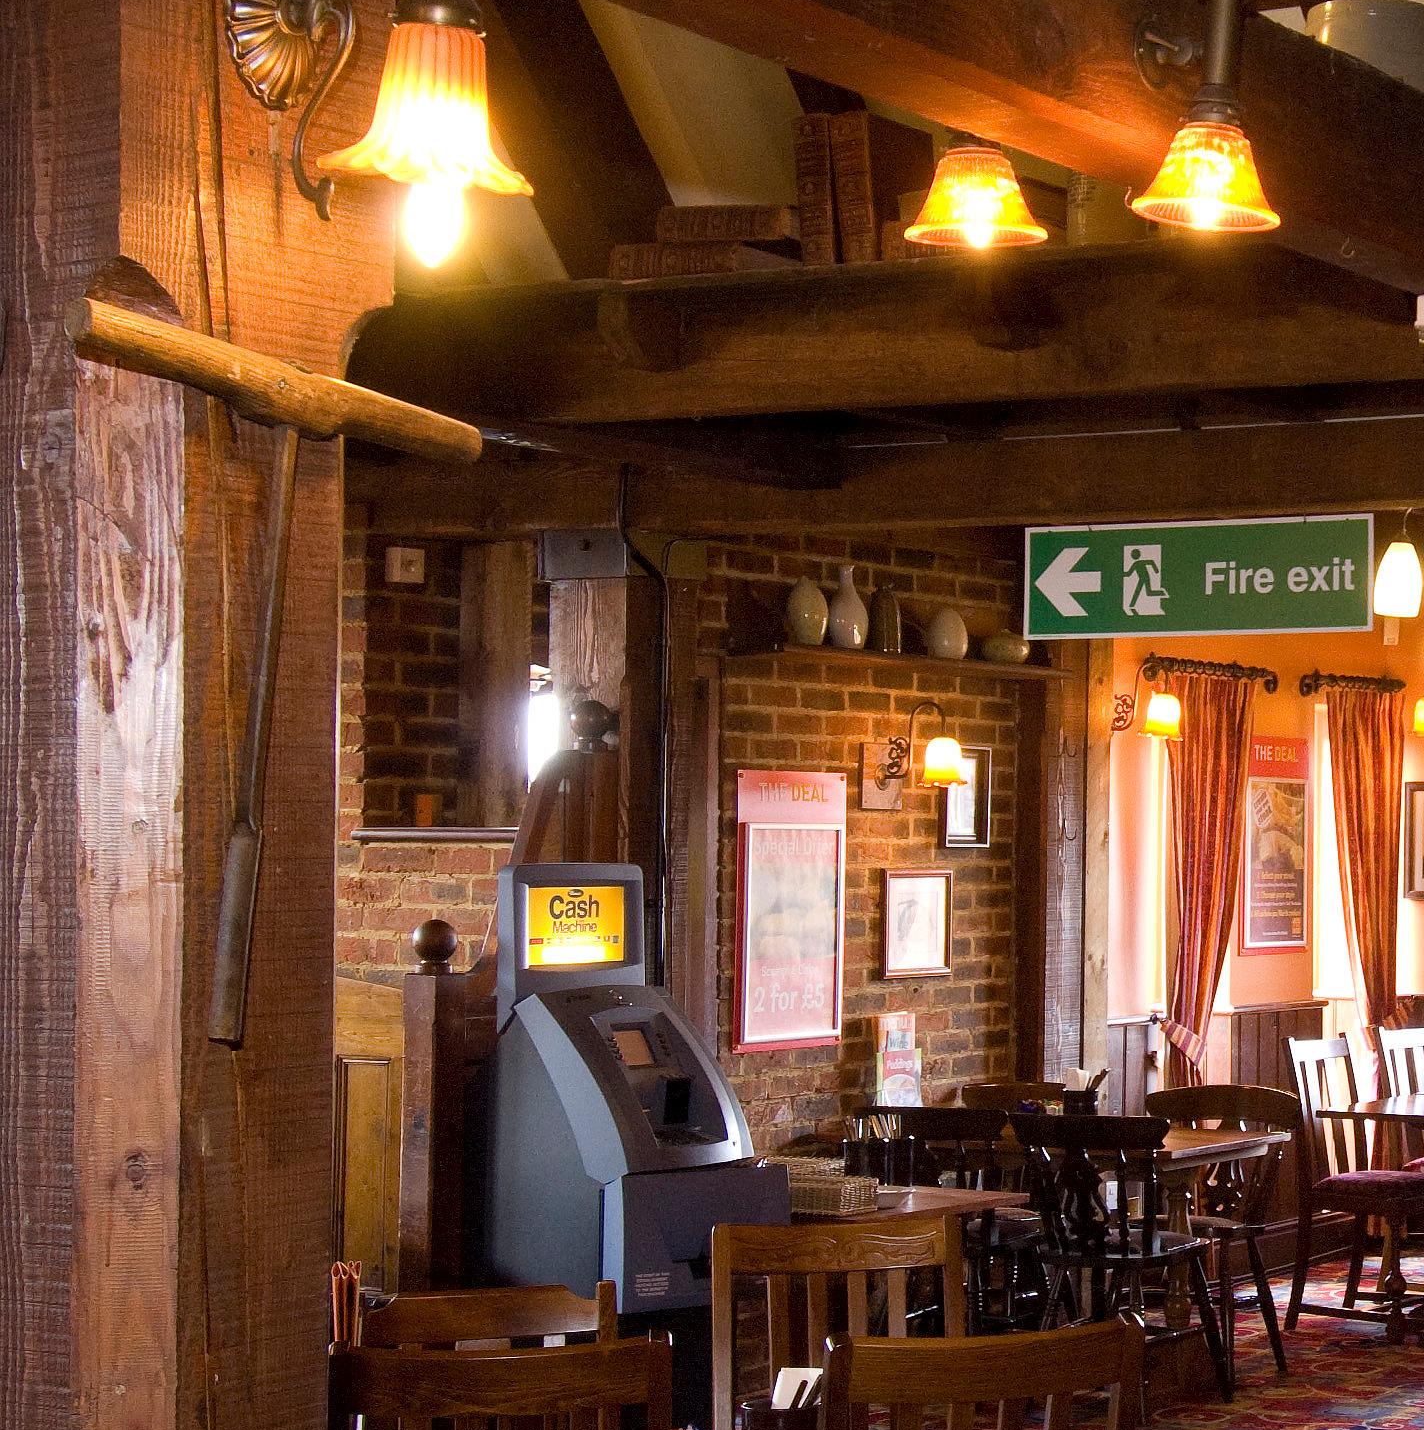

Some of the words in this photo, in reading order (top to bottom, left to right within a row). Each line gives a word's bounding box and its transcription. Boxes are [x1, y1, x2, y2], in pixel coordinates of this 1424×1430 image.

[1205, 561, 1274, 595] Fire
[1287, 557, 1355, 592] exit
[1254, 744, 1273, 762] THE
[1274, 746, 1298, 763] DEAL
[759, 782, 787, 802] THE
[790, 783, 829, 803] DEAL
[549, 894, 600, 920] Cash
[552, 919, 598, 933] Machine
[753, 986, 766, 1013] 2
[769, 981, 800, 1013] for
[889, 1037, 910, 1049] Wine
[886, 1057, 914, 1072] Puddings
